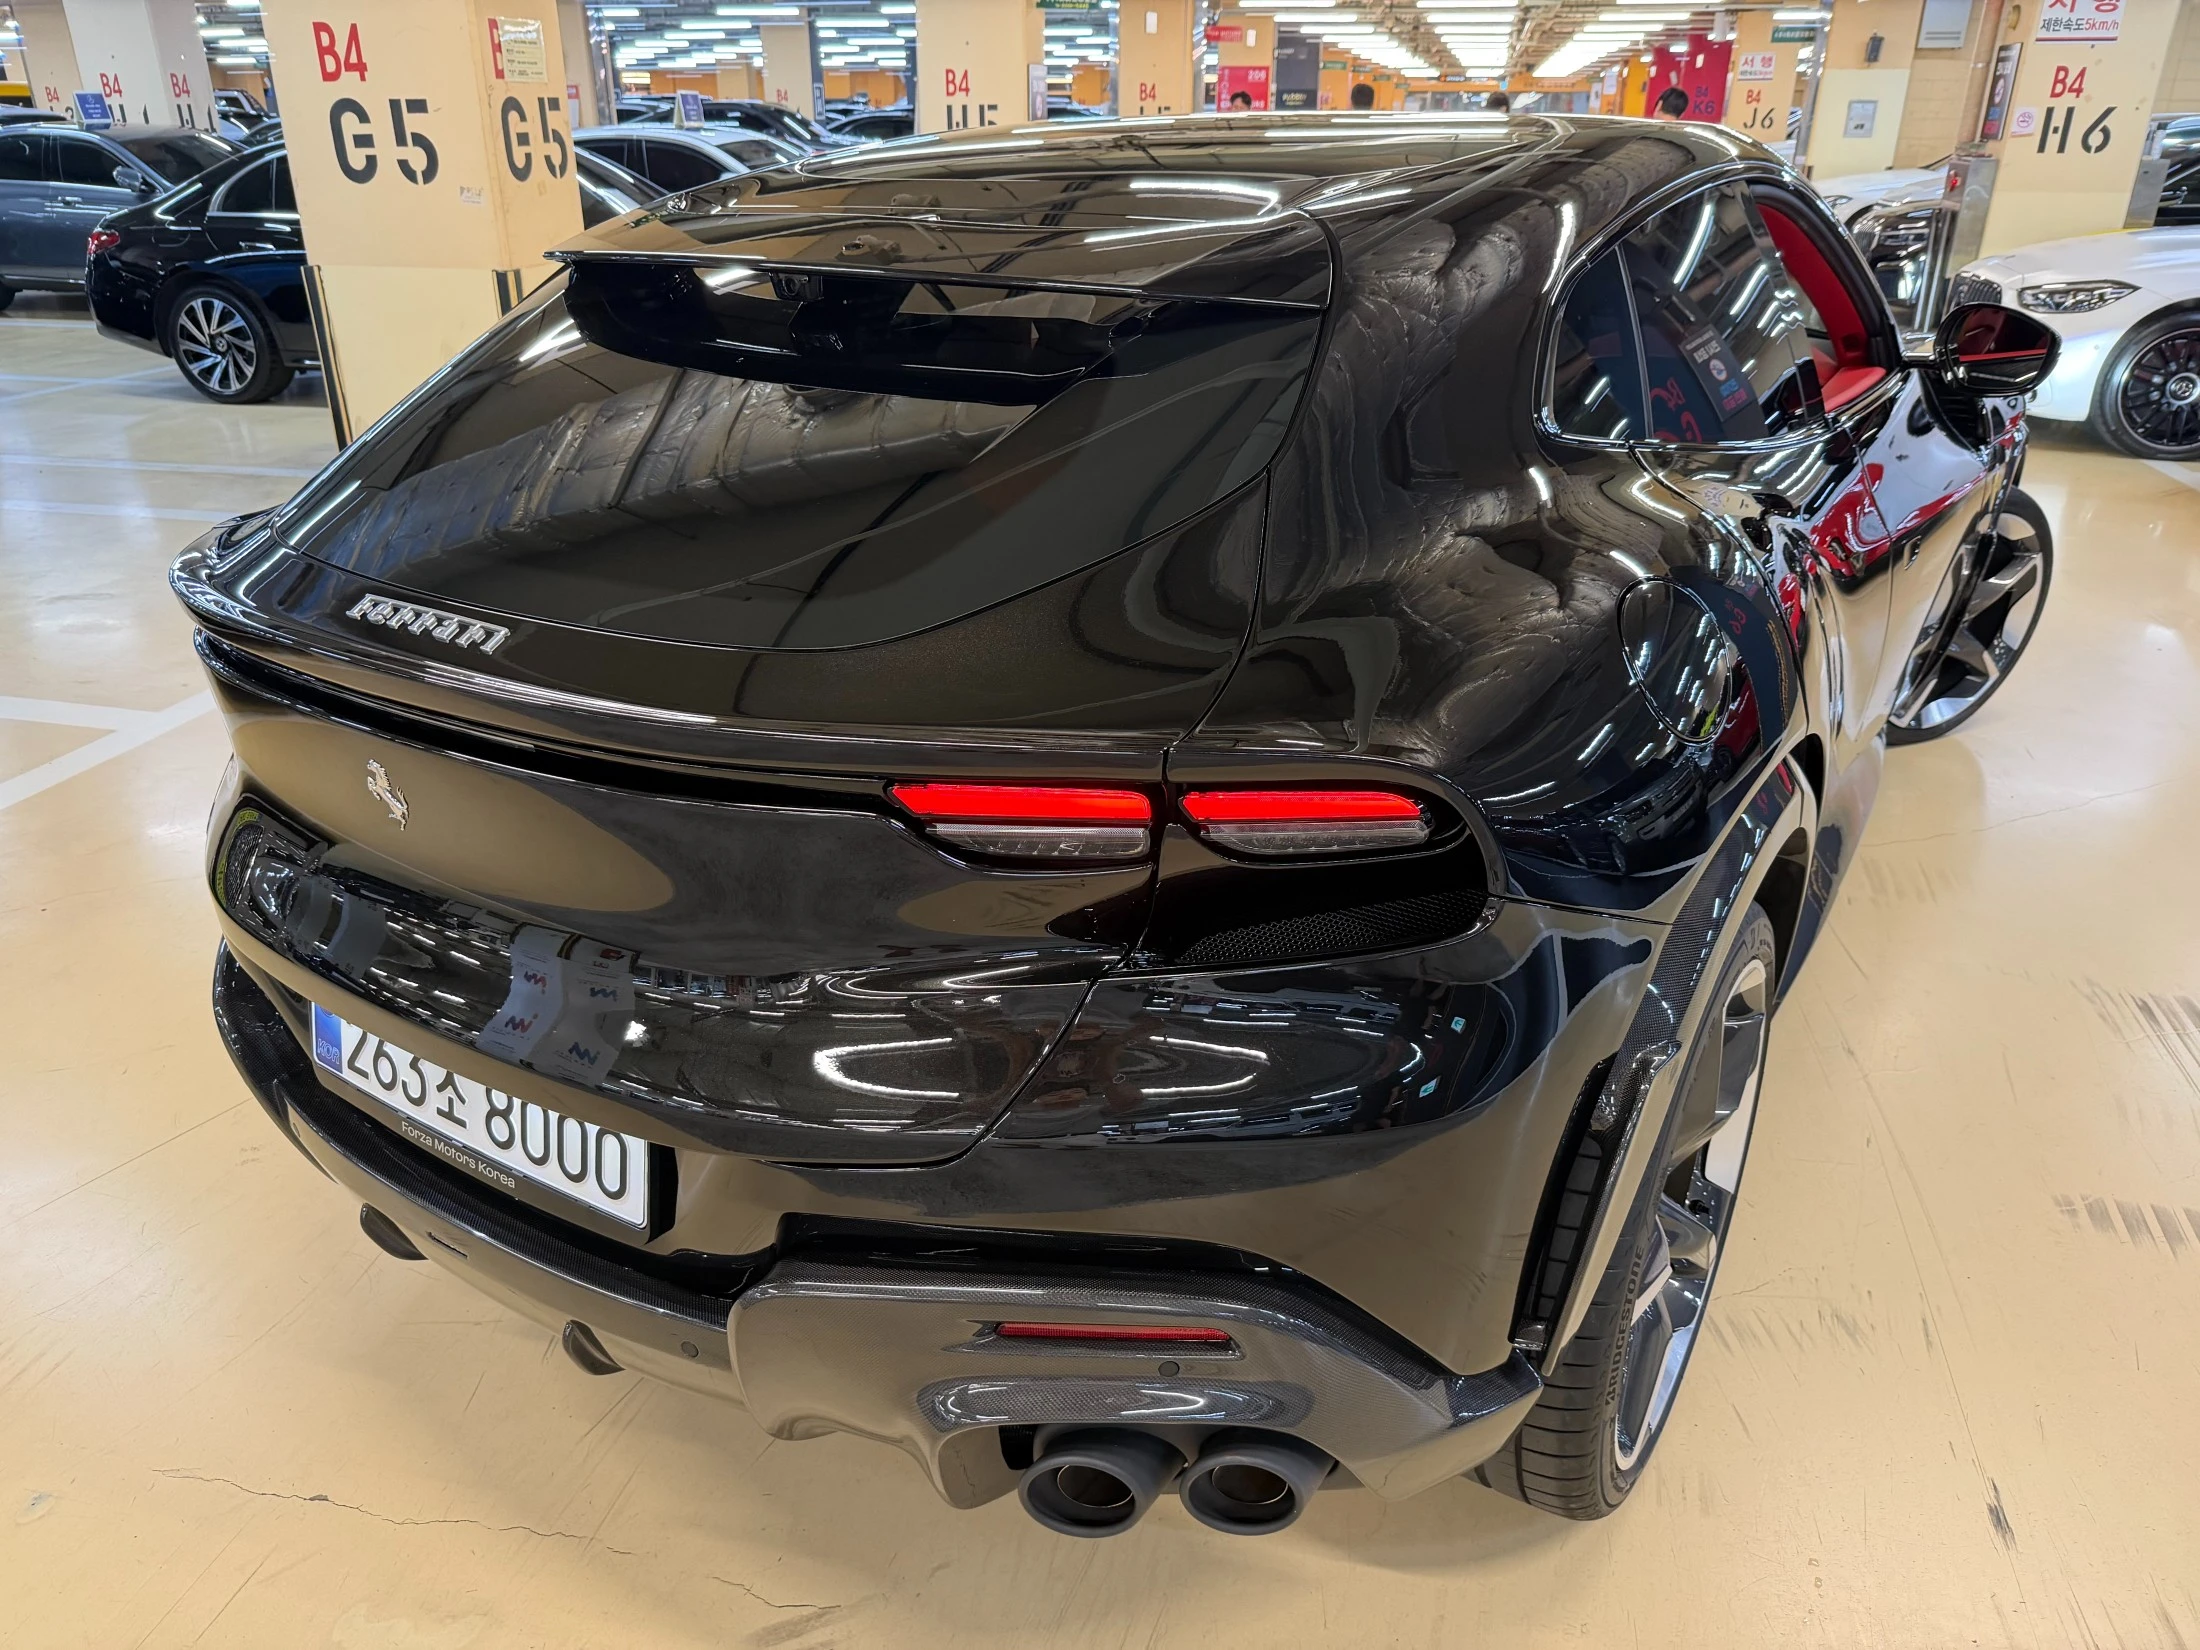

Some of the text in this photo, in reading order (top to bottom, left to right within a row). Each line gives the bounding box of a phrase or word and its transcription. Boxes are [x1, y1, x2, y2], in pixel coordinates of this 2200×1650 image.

[2040, 17, 2119, 32] 제한속도5km/h
[312, 22, 368, 82] B4
[45, 86, 59, 103] B4
[99, 73, 122, 98] B4
[170, 73, 190, 98] B4
[945, 69, 970, 97] B4
[1139, 83, 1156, 101] B4
[2050, 66, 2087, 98] B4
[1693, 100, 1716, 115] K6
[1746, 89, 1761, 104] B4
[346, 593, 511, 655] Ferrari
[317, 1037, 340, 1065] KOR
[401, 1121, 515, 1188] Forza Motors Korea
[486, 1086, 628, 1200] 8000
